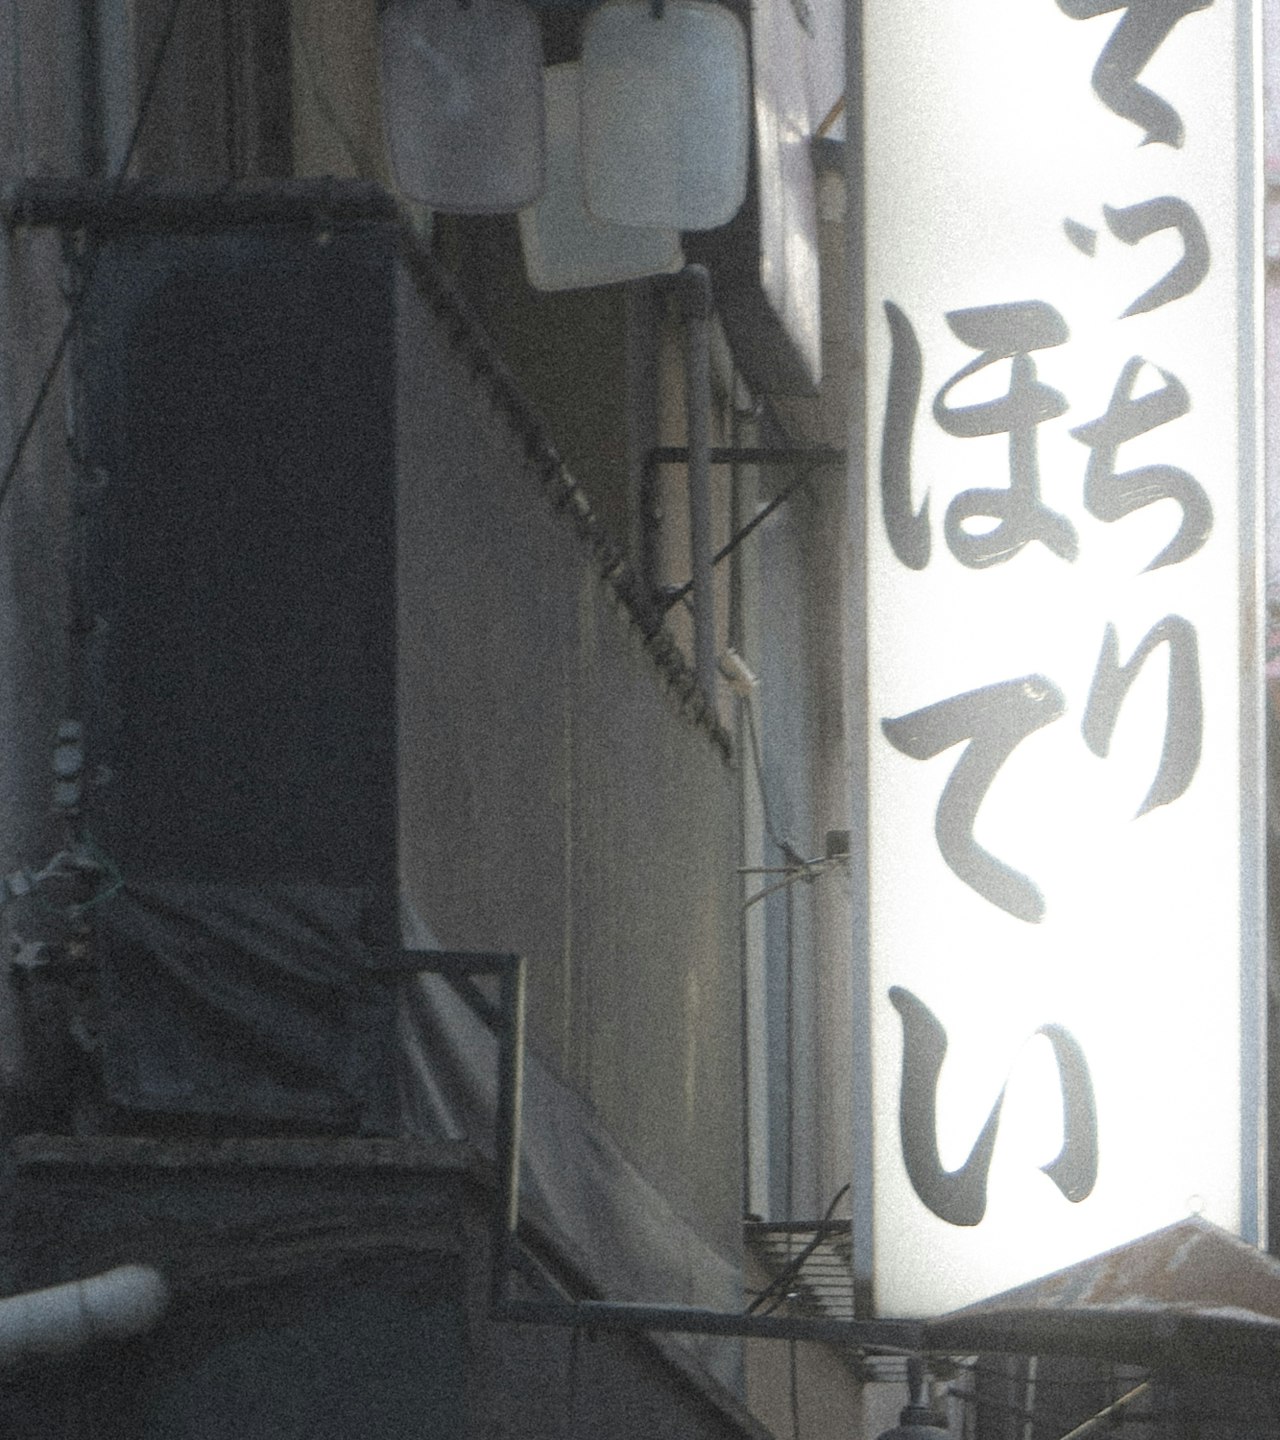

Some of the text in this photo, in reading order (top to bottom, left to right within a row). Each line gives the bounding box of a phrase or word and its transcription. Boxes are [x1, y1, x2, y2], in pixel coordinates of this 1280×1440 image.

[880, 299, 1098, 1227] ほてい
[1056, 0, 1215, 819] てっちり
